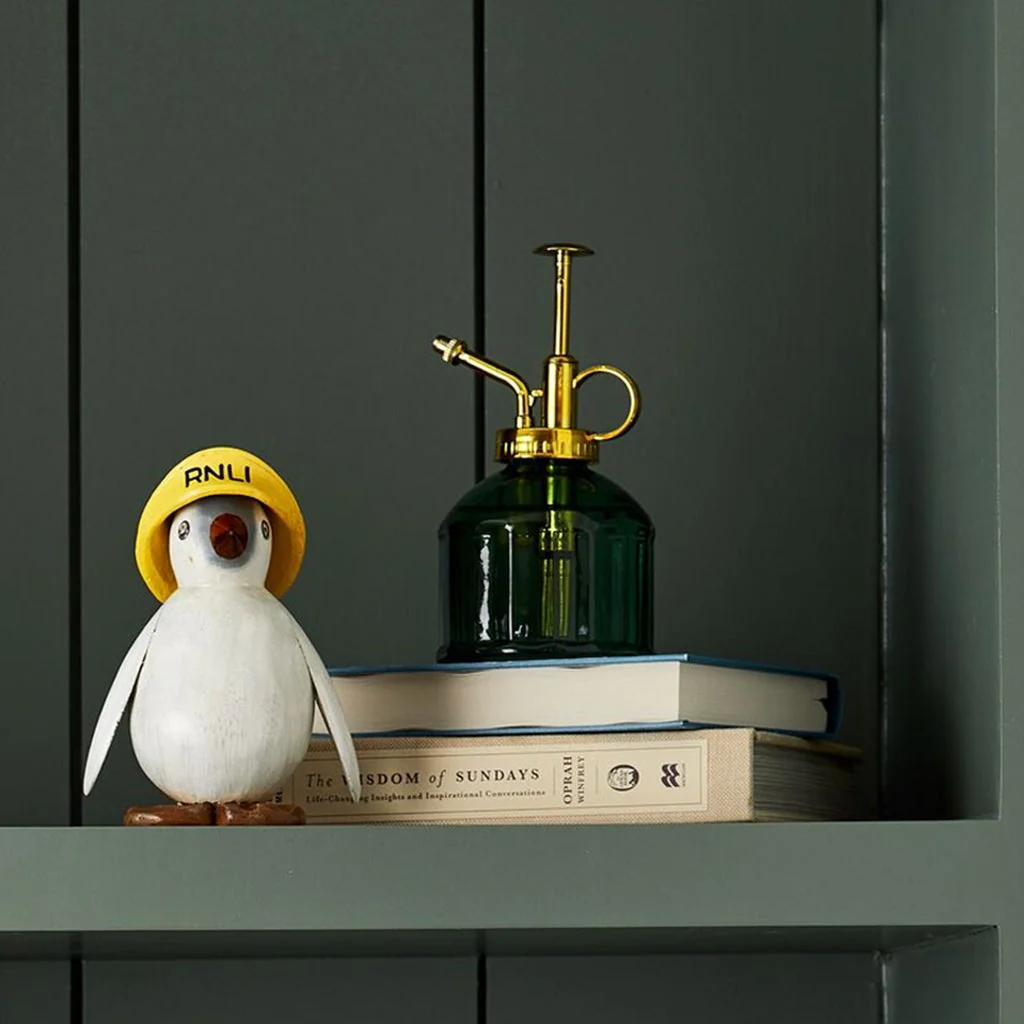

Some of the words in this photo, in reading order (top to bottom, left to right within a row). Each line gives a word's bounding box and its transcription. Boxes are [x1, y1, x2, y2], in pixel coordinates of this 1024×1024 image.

[183, 463, 252, 488] RNLI
[306, 773, 333, 788] The
[341, 771, 419, 787] ISDOM
[428, 769, 447, 788] of
[455, 768, 541, 783] SUNDAYS
[563, 756, 573, 804] OPRAH
[577, 756, 585, 804] WINFREY
[371, 792, 405, 803] Insights
[407, 792, 423, 800] and
[425, 788, 482, 801] Inspirational
[485, 786, 546, 797] Conversations
